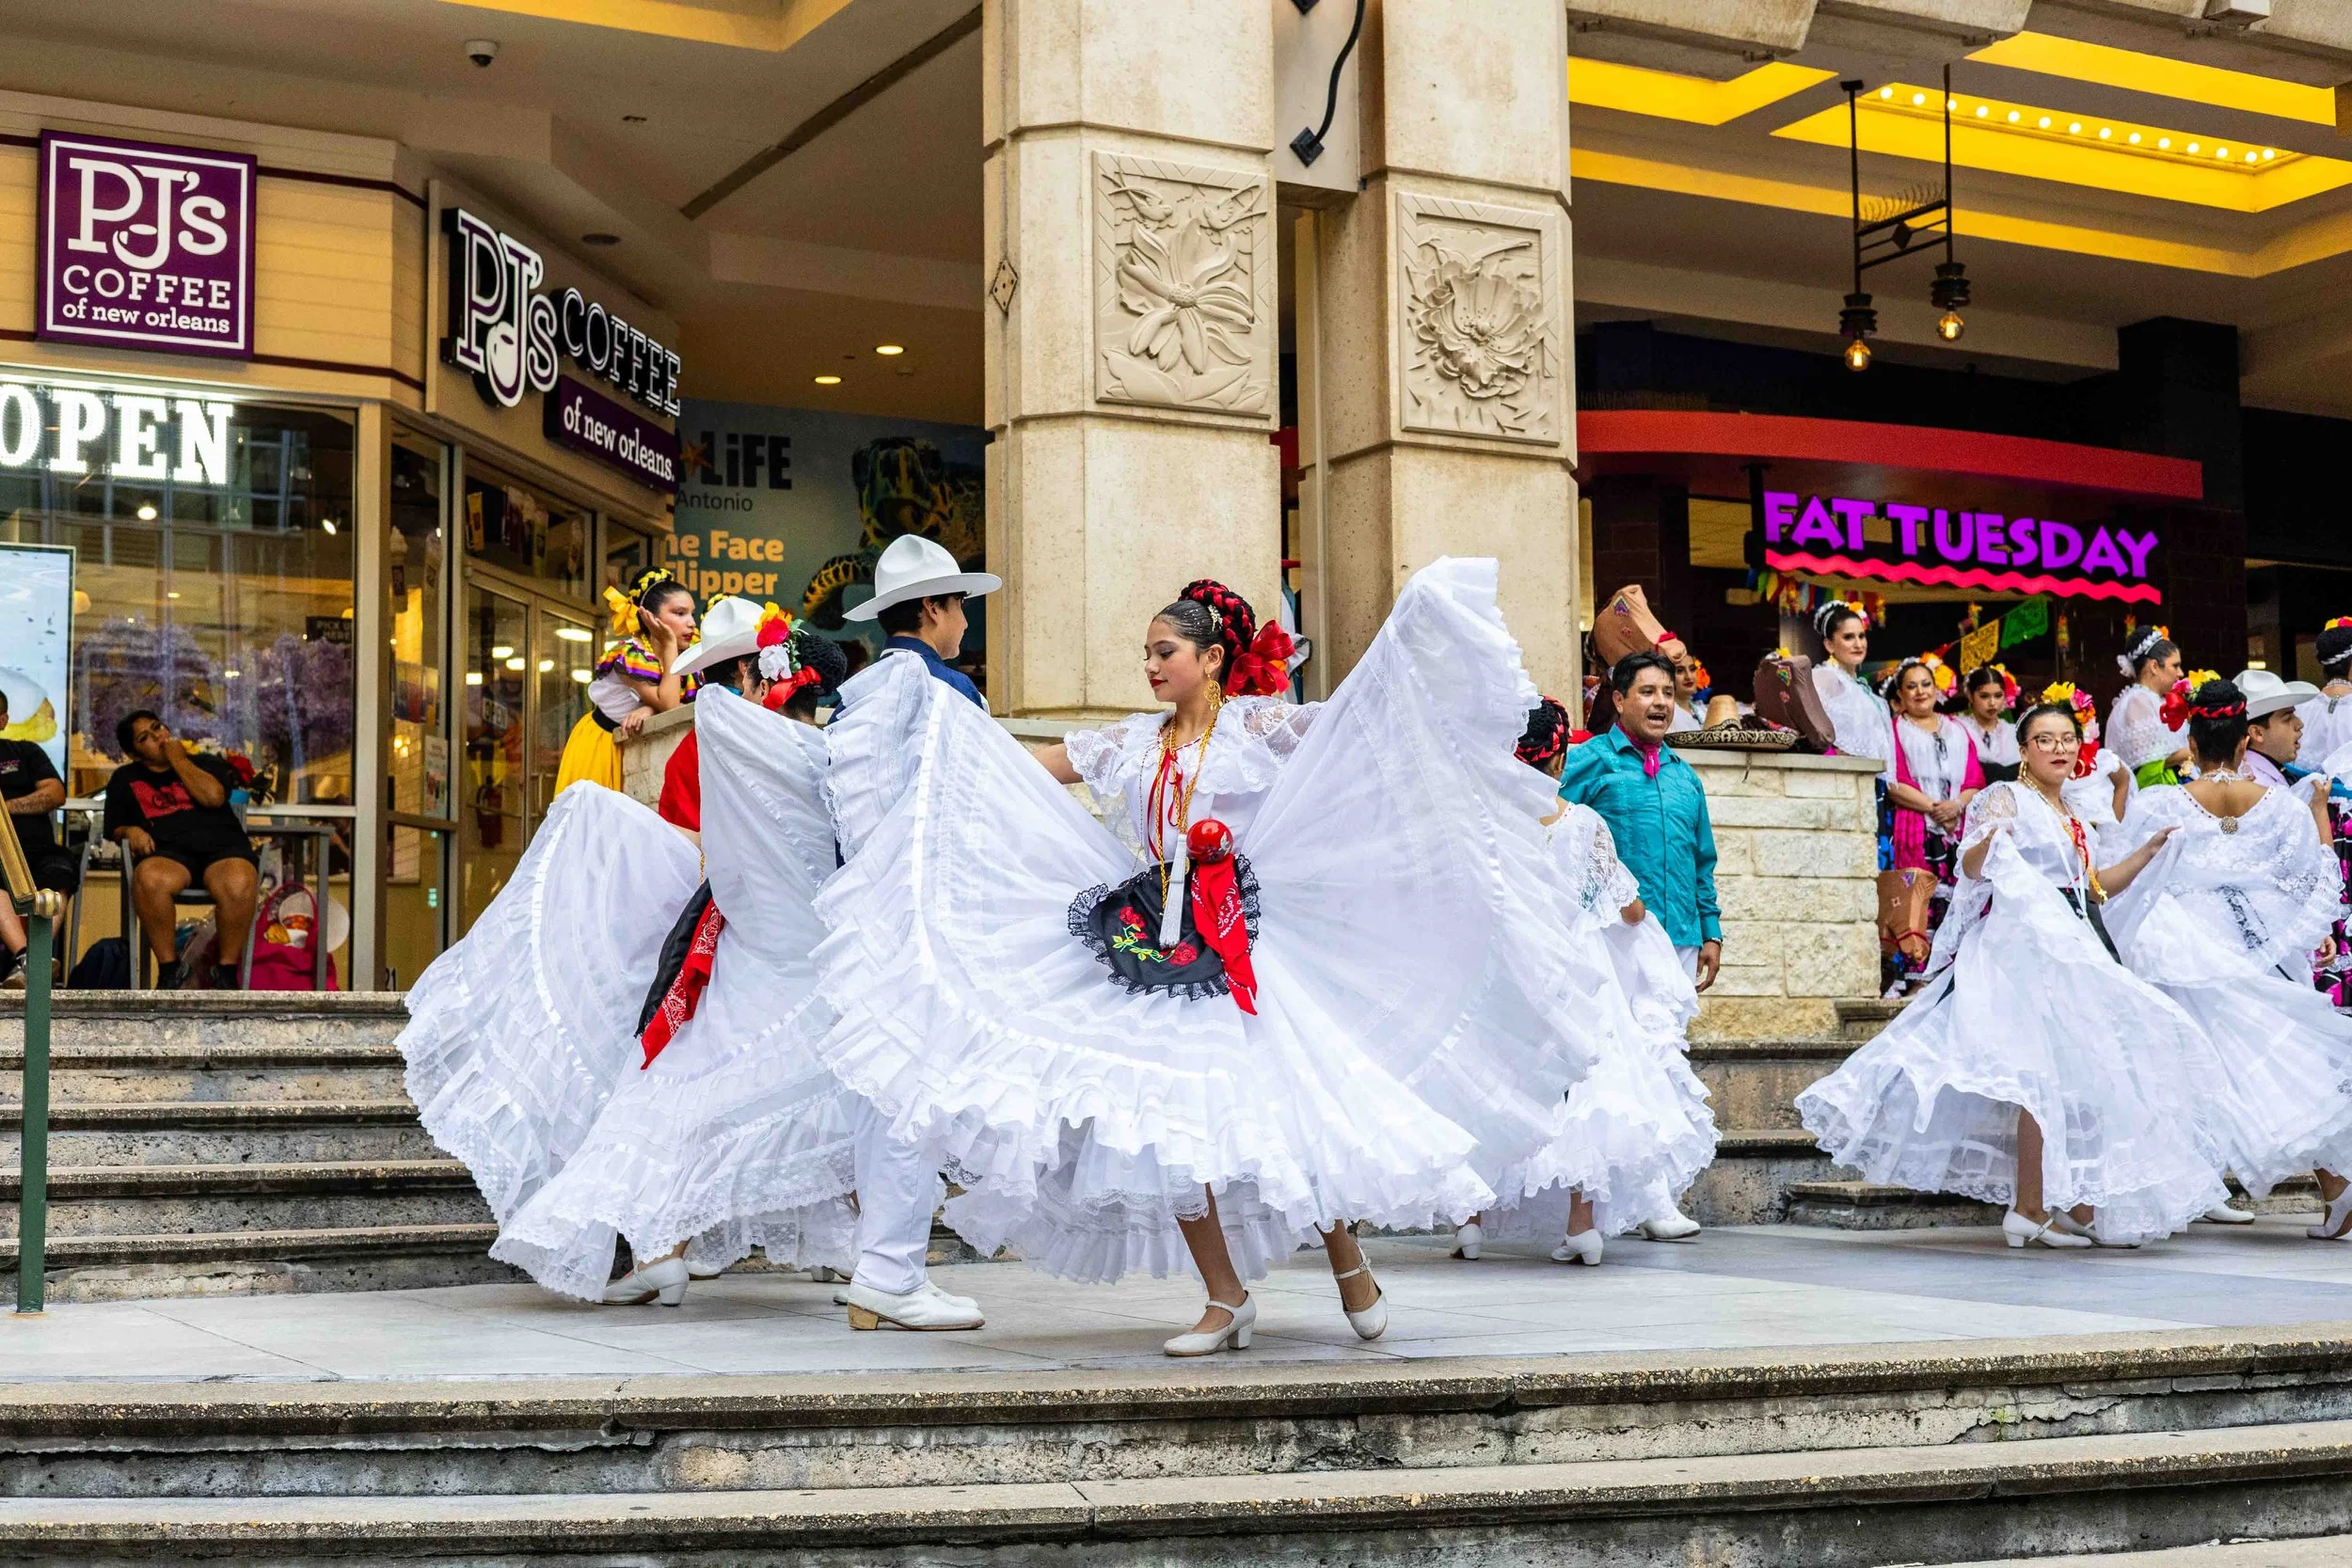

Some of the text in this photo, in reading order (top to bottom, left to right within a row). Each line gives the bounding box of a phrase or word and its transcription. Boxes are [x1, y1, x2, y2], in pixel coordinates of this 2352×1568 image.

[68, 157, 228, 270] PJ's
[62, 297, 230, 334] of new orleans
[63, 264, 230, 309] COFFEE
[456, 208, 559, 407] PJ's
[563, 287, 681, 417] COFFEE
[0, 383, 234, 485] OPEN
[564, 395, 582, 435] of
[584, 414, 616, 452] new
[675, 490, 754, 512] Antonio
[1763, 491, 2159, 578] FAT TUESDAY
[709, 529, 785, 562] Face
